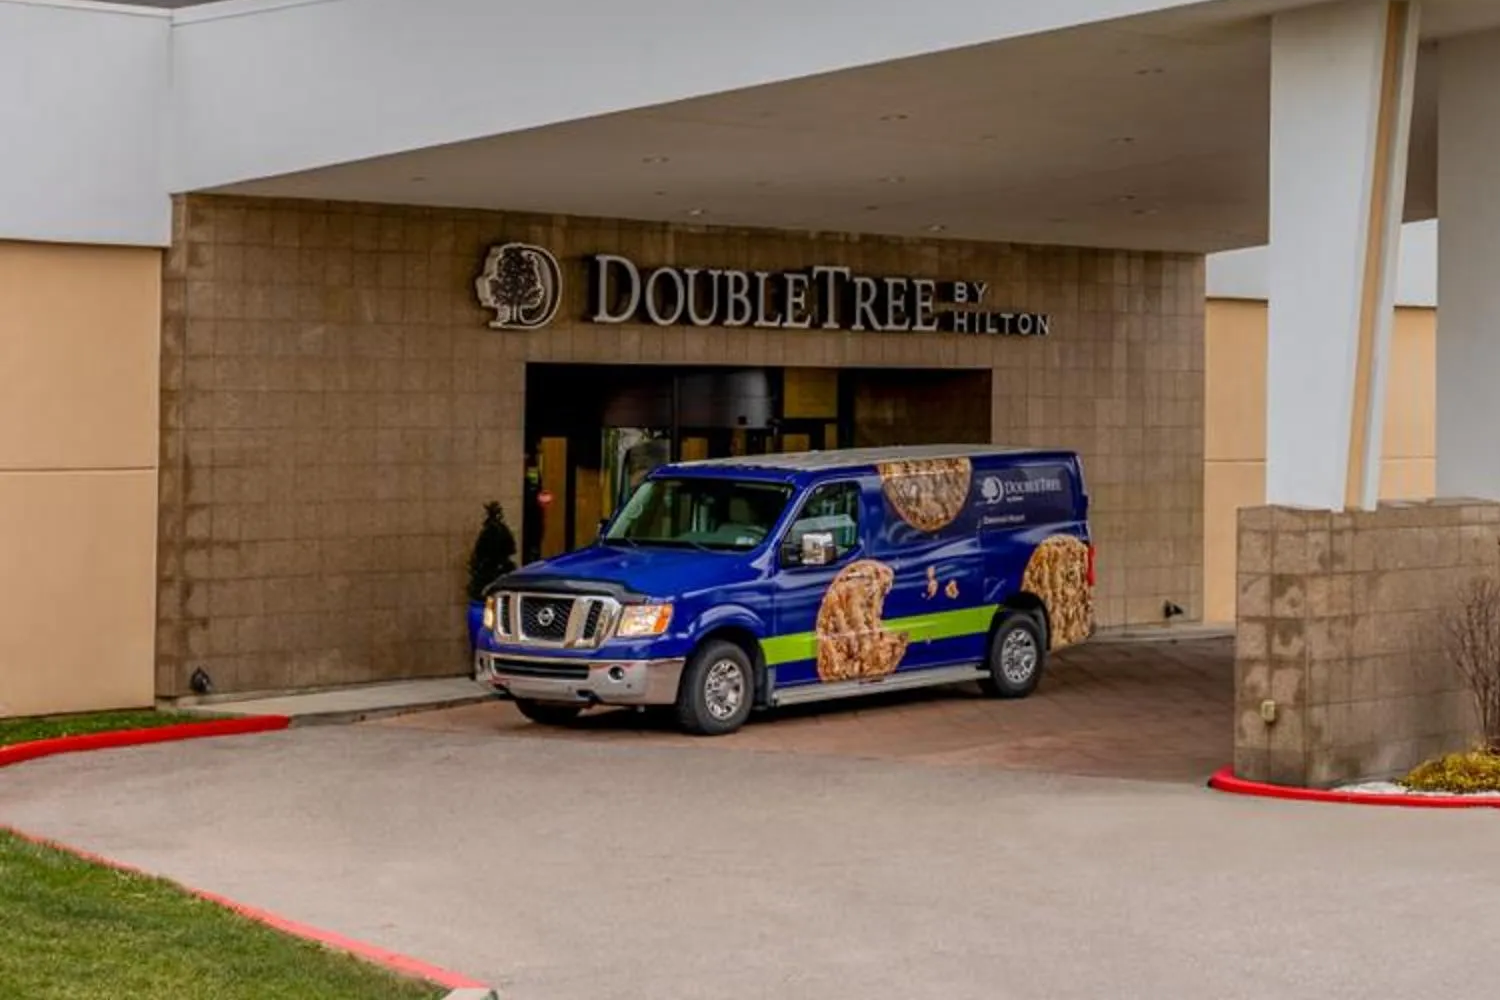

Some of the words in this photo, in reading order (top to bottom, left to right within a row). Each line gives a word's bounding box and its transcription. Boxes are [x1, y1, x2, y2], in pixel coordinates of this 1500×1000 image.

[592, 254, 940, 332] DOUBLETREE
[953, 281, 989, 303] BY
[953, 311, 1050, 336] HILTON
